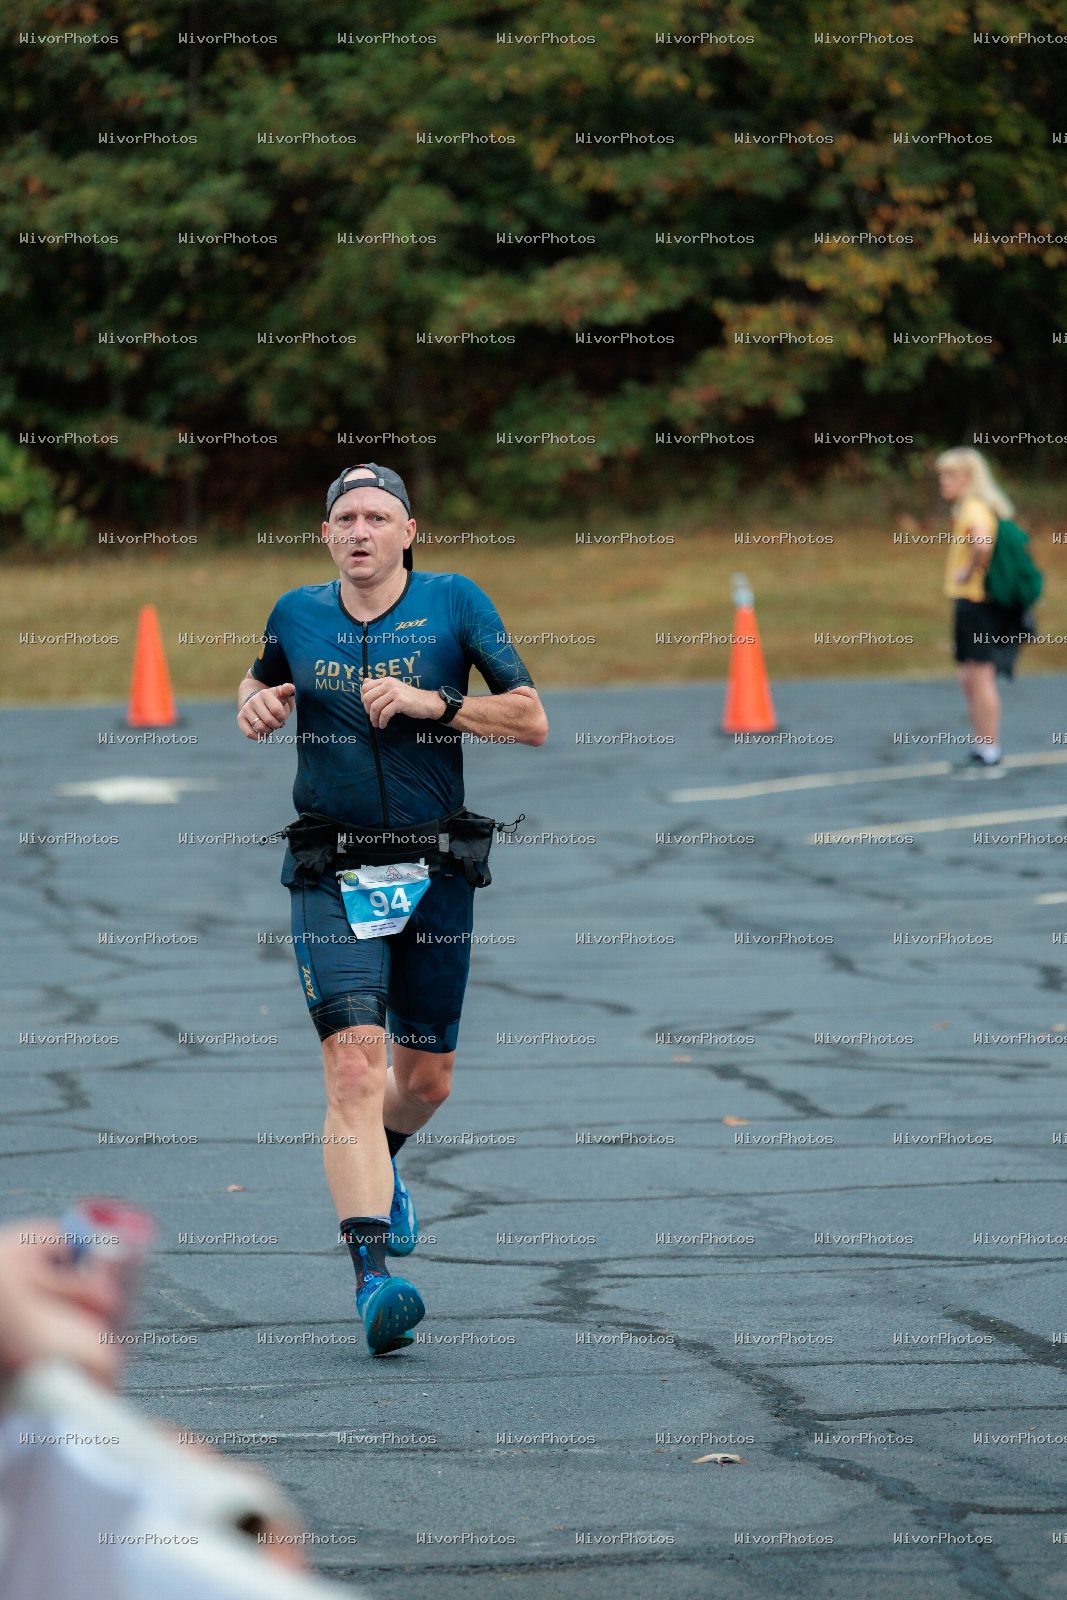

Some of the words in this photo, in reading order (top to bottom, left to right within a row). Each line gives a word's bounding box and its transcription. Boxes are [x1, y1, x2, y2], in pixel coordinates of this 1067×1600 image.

[315, 656, 415, 681] ODYSSEY
[315, 675, 422, 693] MULTIRT
[369, 887, 412, 917] 94
